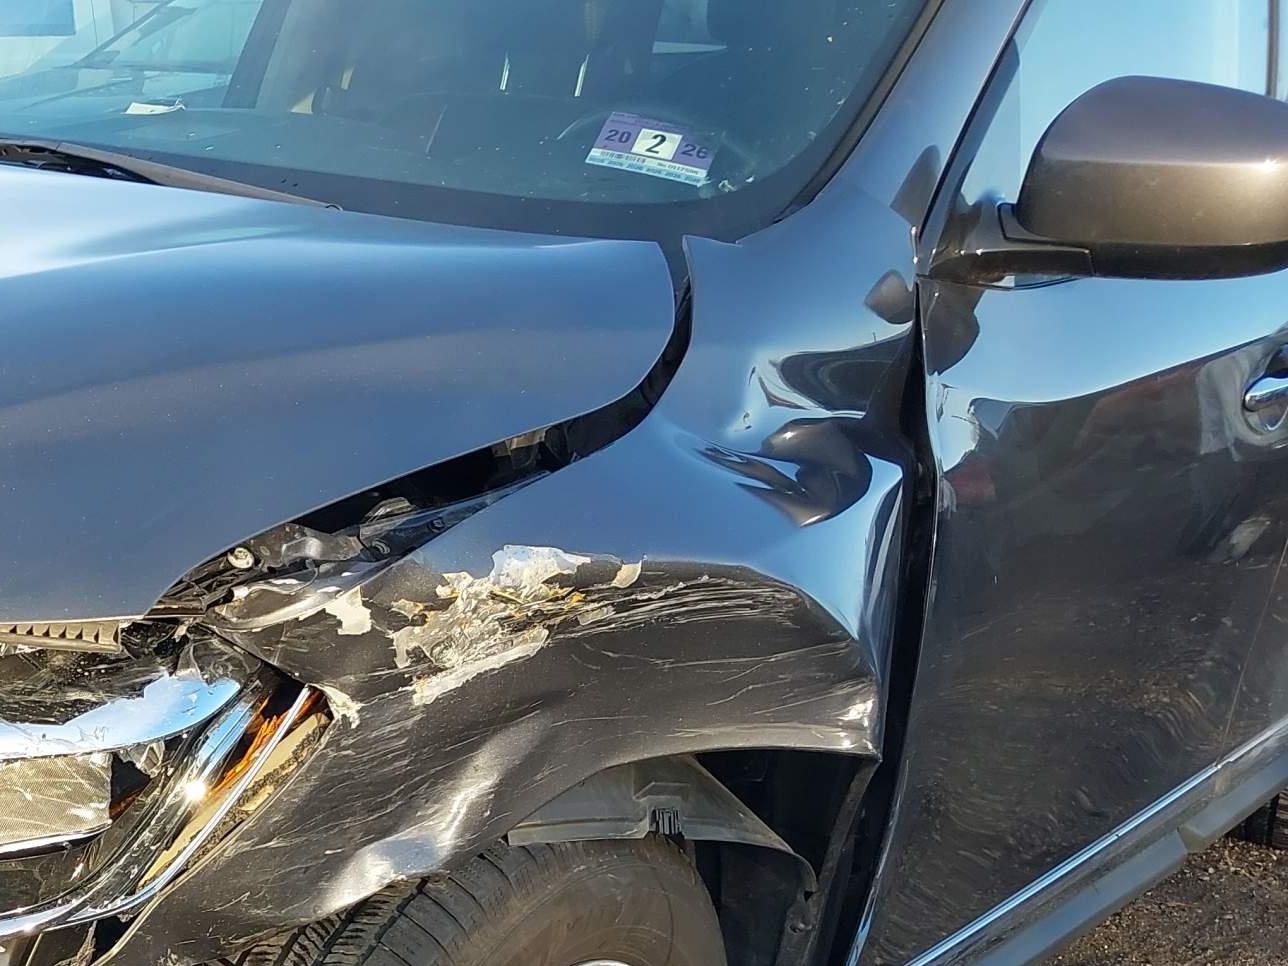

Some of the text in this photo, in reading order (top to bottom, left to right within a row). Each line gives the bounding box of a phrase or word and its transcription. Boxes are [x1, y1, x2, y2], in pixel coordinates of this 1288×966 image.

[605, 129, 709, 159] 20 2 26
